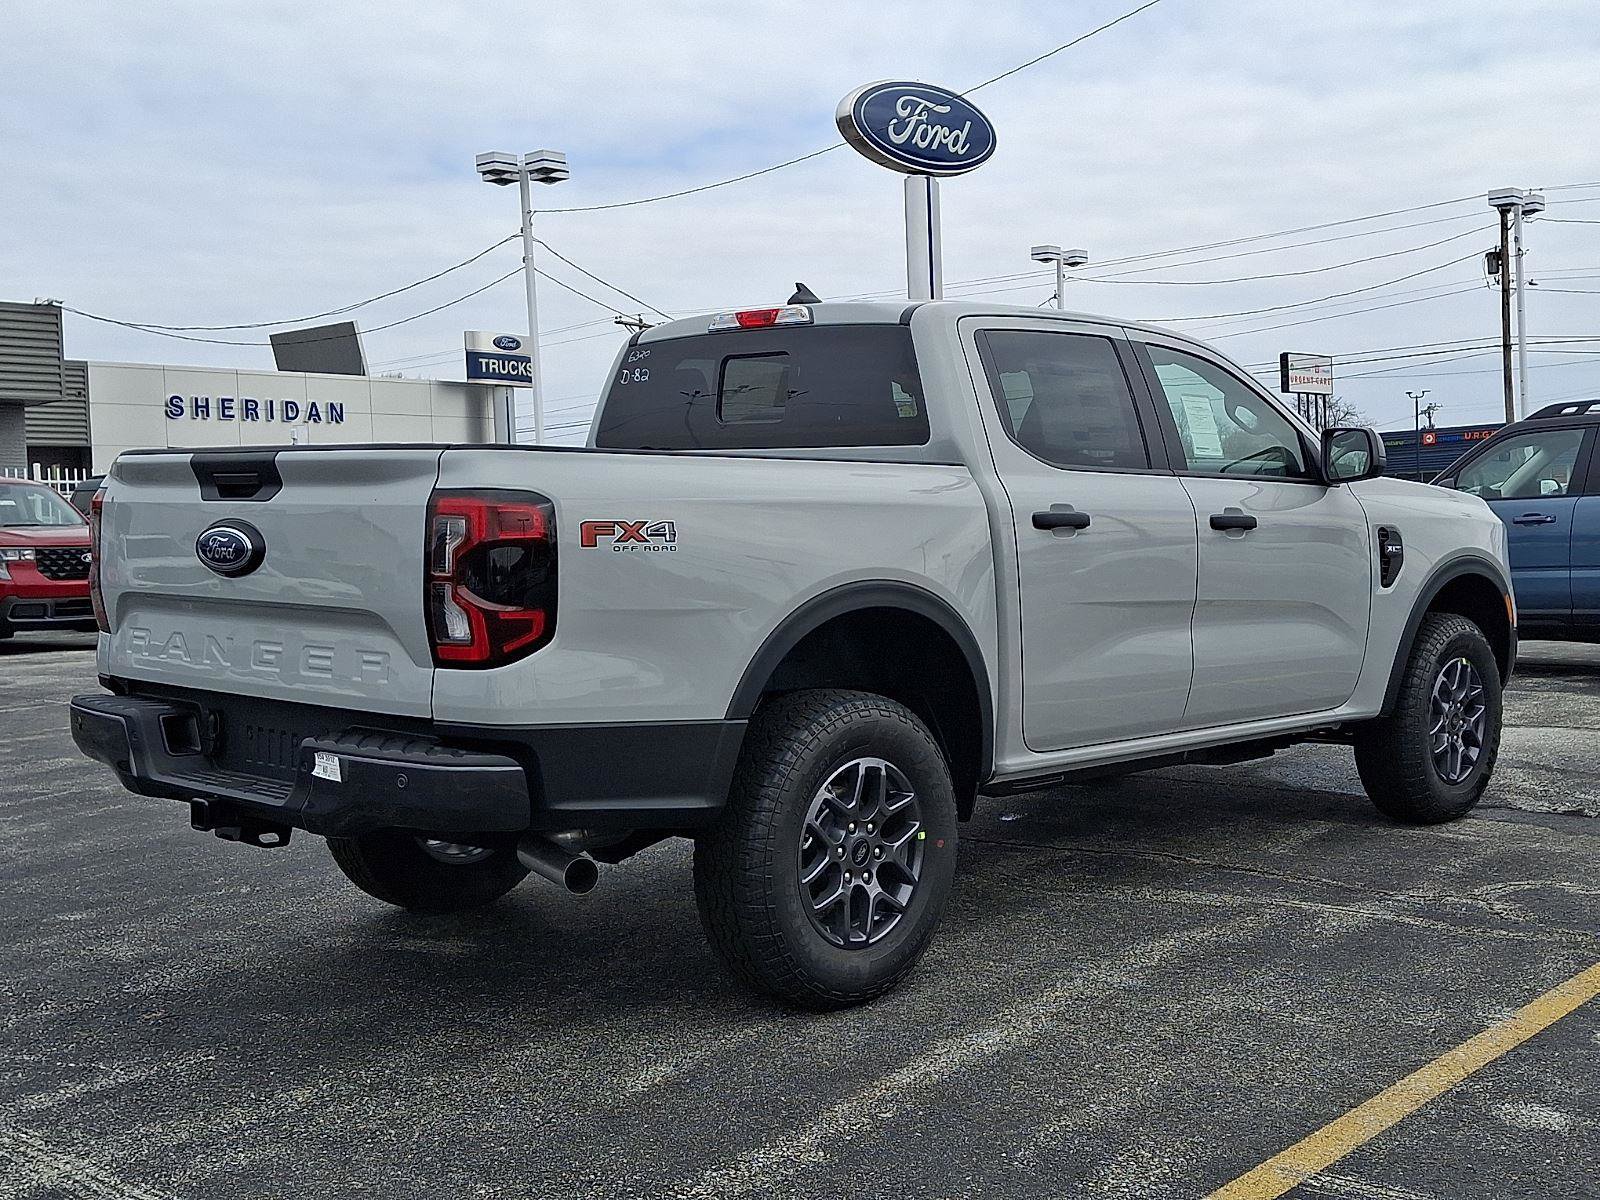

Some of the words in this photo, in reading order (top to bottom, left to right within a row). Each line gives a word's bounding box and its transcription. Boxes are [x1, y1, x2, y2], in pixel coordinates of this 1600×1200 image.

[888, 95, 972, 155] Ford
[500, 337, 517, 348] Ford
[479, 358, 533, 377] TRUCKS
[620, 368, 650, 384] D-82
[1290, 375, 1314, 384] URGENT
[1315, 377, 1331, 386] CARE
[165, 395, 345, 423] SHERIDAN
[580, 519, 678, 549] FX4
[206, 535, 236, 560] Ford
[127, 626, 390, 684] RANGER
